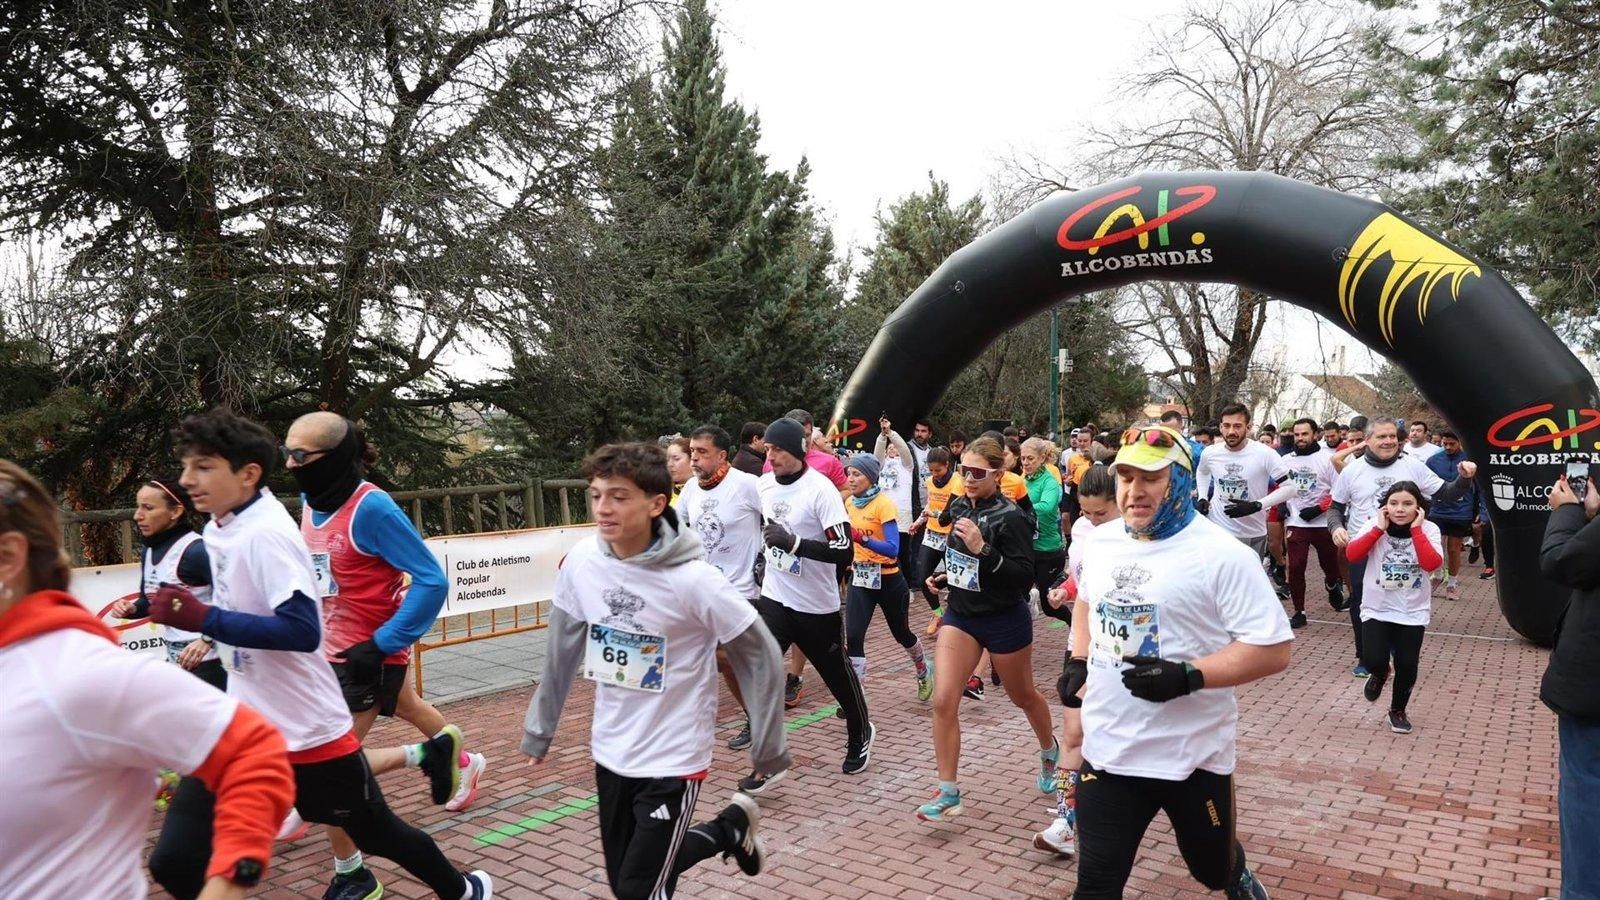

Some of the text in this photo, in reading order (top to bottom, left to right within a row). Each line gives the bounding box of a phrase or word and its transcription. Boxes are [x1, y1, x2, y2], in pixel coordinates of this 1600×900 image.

[1061, 248, 1214, 277] ALCOBENDAS
[1222, 486, 1237, 494] 117
[1516, 502, 1527, 510] Un
[772, 547, 783, 559] 67
[456, 555, 531, 571] Club de Atletismo
[947, 561, 965, 576] 287
[456, 574, 490, 587] Popular
[1385, 573, 1410, 581] 226
[456, 587, 506, 601] Alcobendas
[591, 624, 608, 645] 5K
[1101, 618, 1130, 641] 104
[602, 646, 628, 667] 68
